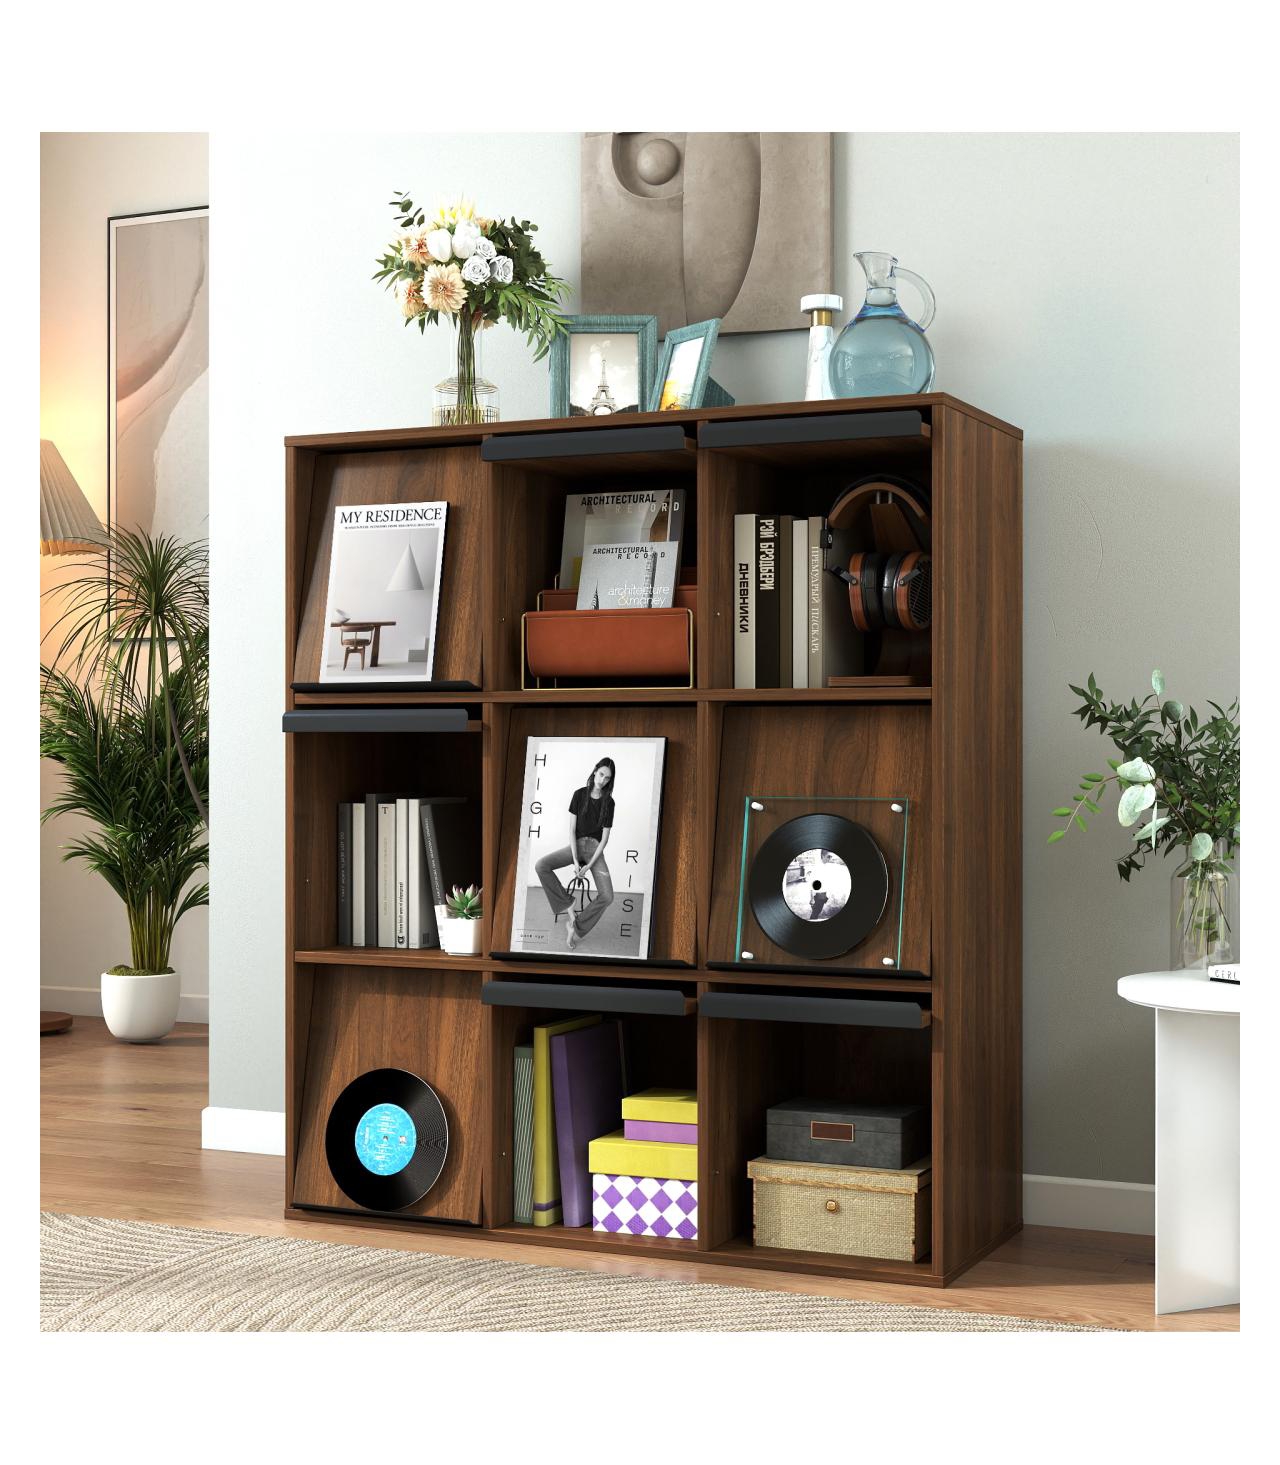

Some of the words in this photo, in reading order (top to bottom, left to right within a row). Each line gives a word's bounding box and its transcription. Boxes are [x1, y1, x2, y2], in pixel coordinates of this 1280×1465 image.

[581, 494, 657, 506] ARCHITECTURAL
[615, 502, 680, 515] REORD
[340, 511, 362, 524] MY
[365, 507, 442, 523] RESIDENCE
[759, 519, 778, 538] РЭЙ
[593, 546, 648, 555] ARCHITECTURAL
[759, 542, 775, 590] БРЭДБЕРИ
[608, 583, 670, 596] architecture
[739, 563, 749, 633] ДНЕВНИКИ
[528, 753, 547, 839] HIGH
[620, 850, 639, 938] RISE
